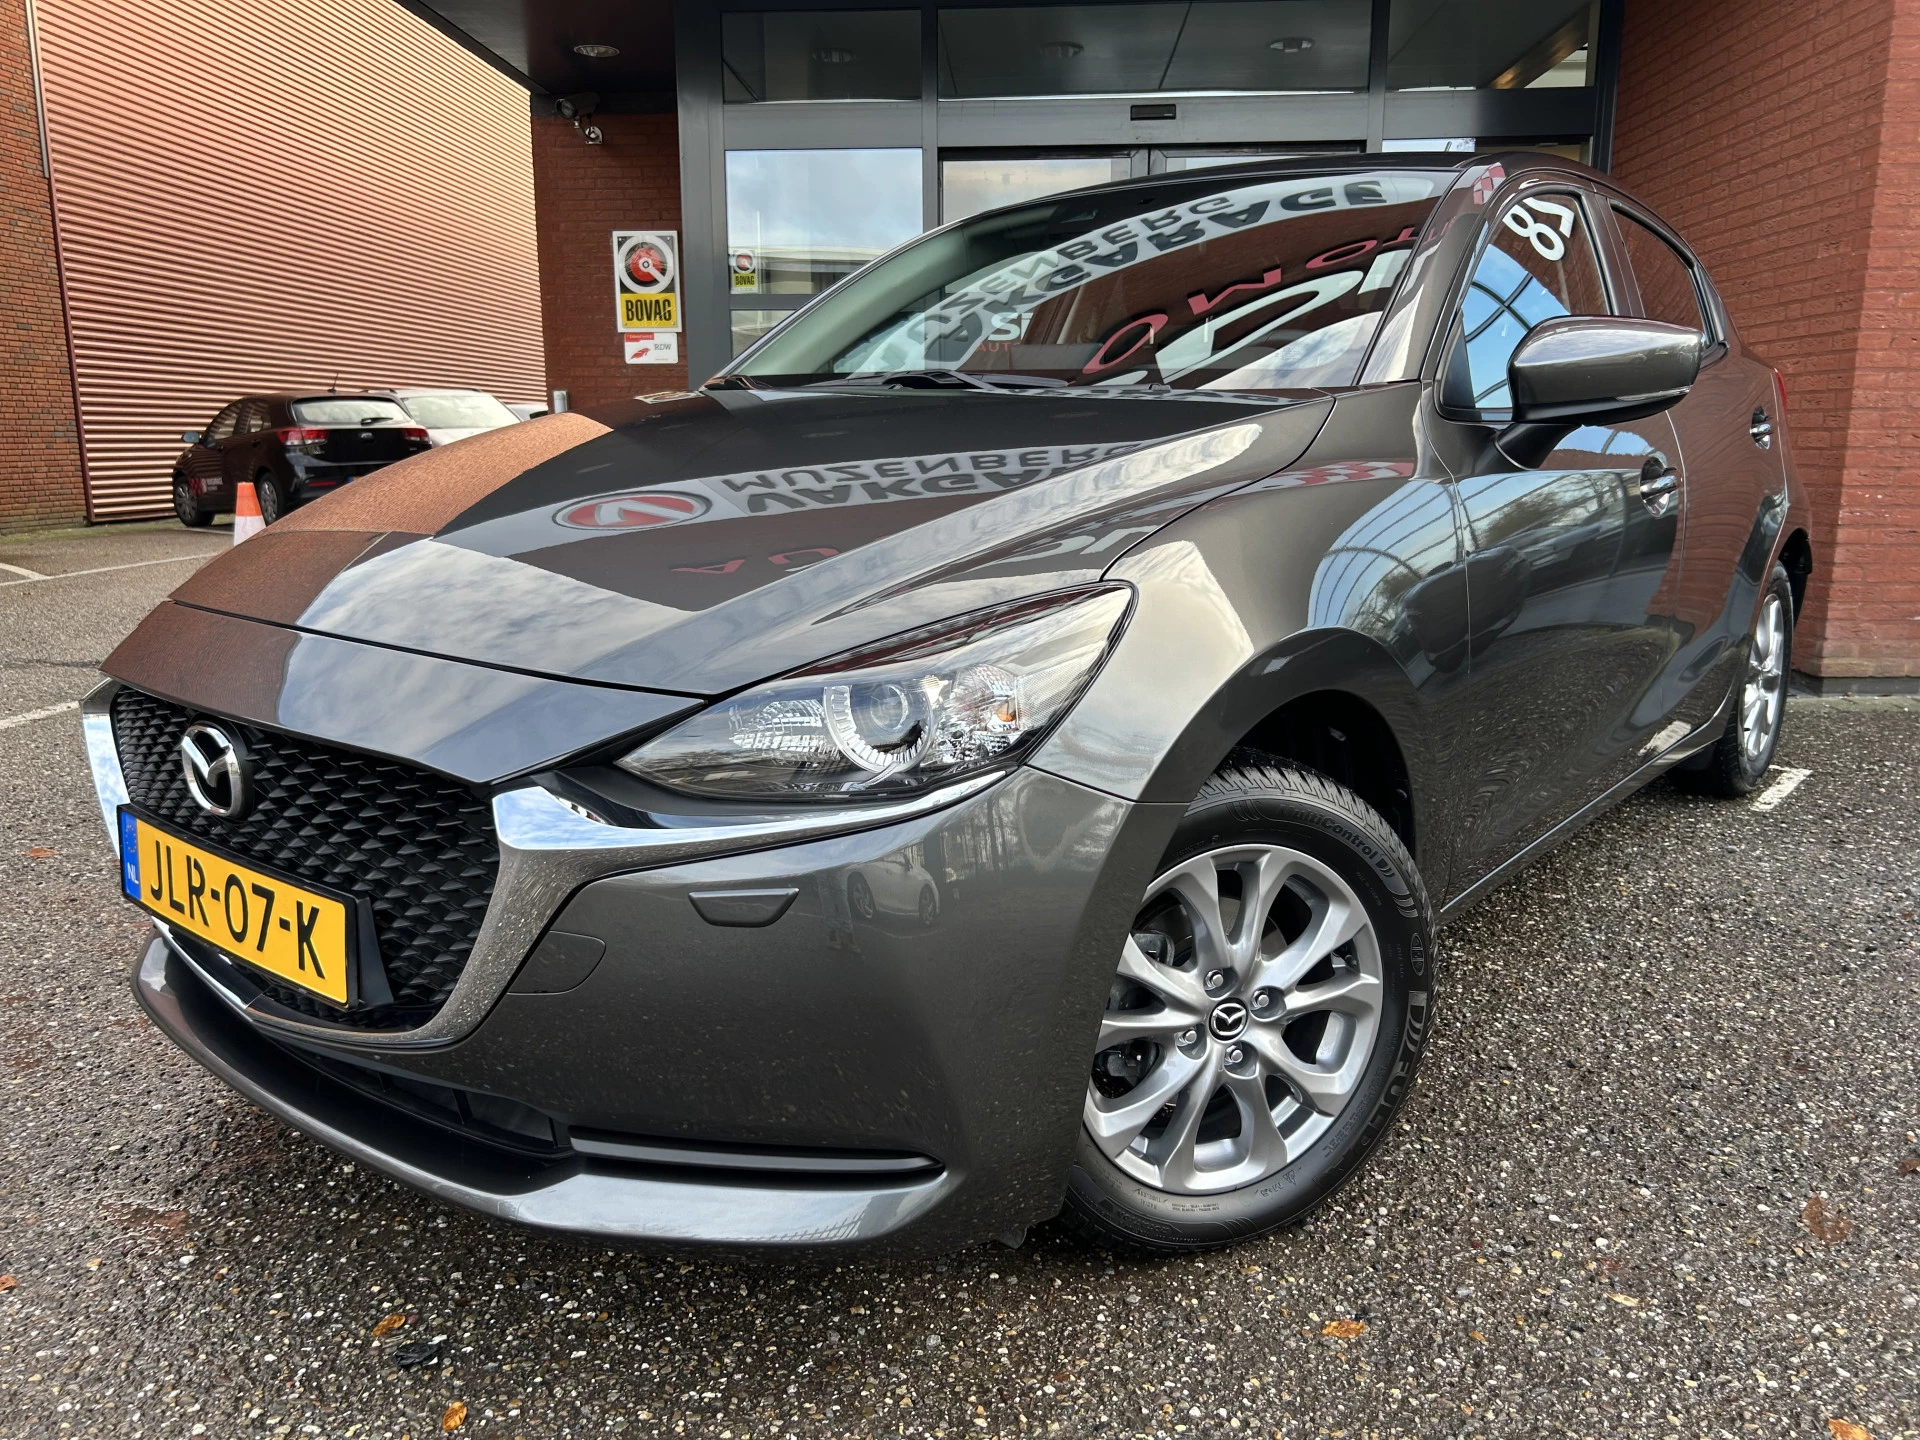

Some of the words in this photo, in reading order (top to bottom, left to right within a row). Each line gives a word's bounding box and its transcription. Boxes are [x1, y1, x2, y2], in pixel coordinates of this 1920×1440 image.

[735, 275, 755, 286] BOVAG
[625, 299, 672, 322] BOVAG
[654, 343, 672, 351] RDW
[127, 862, 139, 885] NL
[150, 840, 326, 979] JLR-07-K
